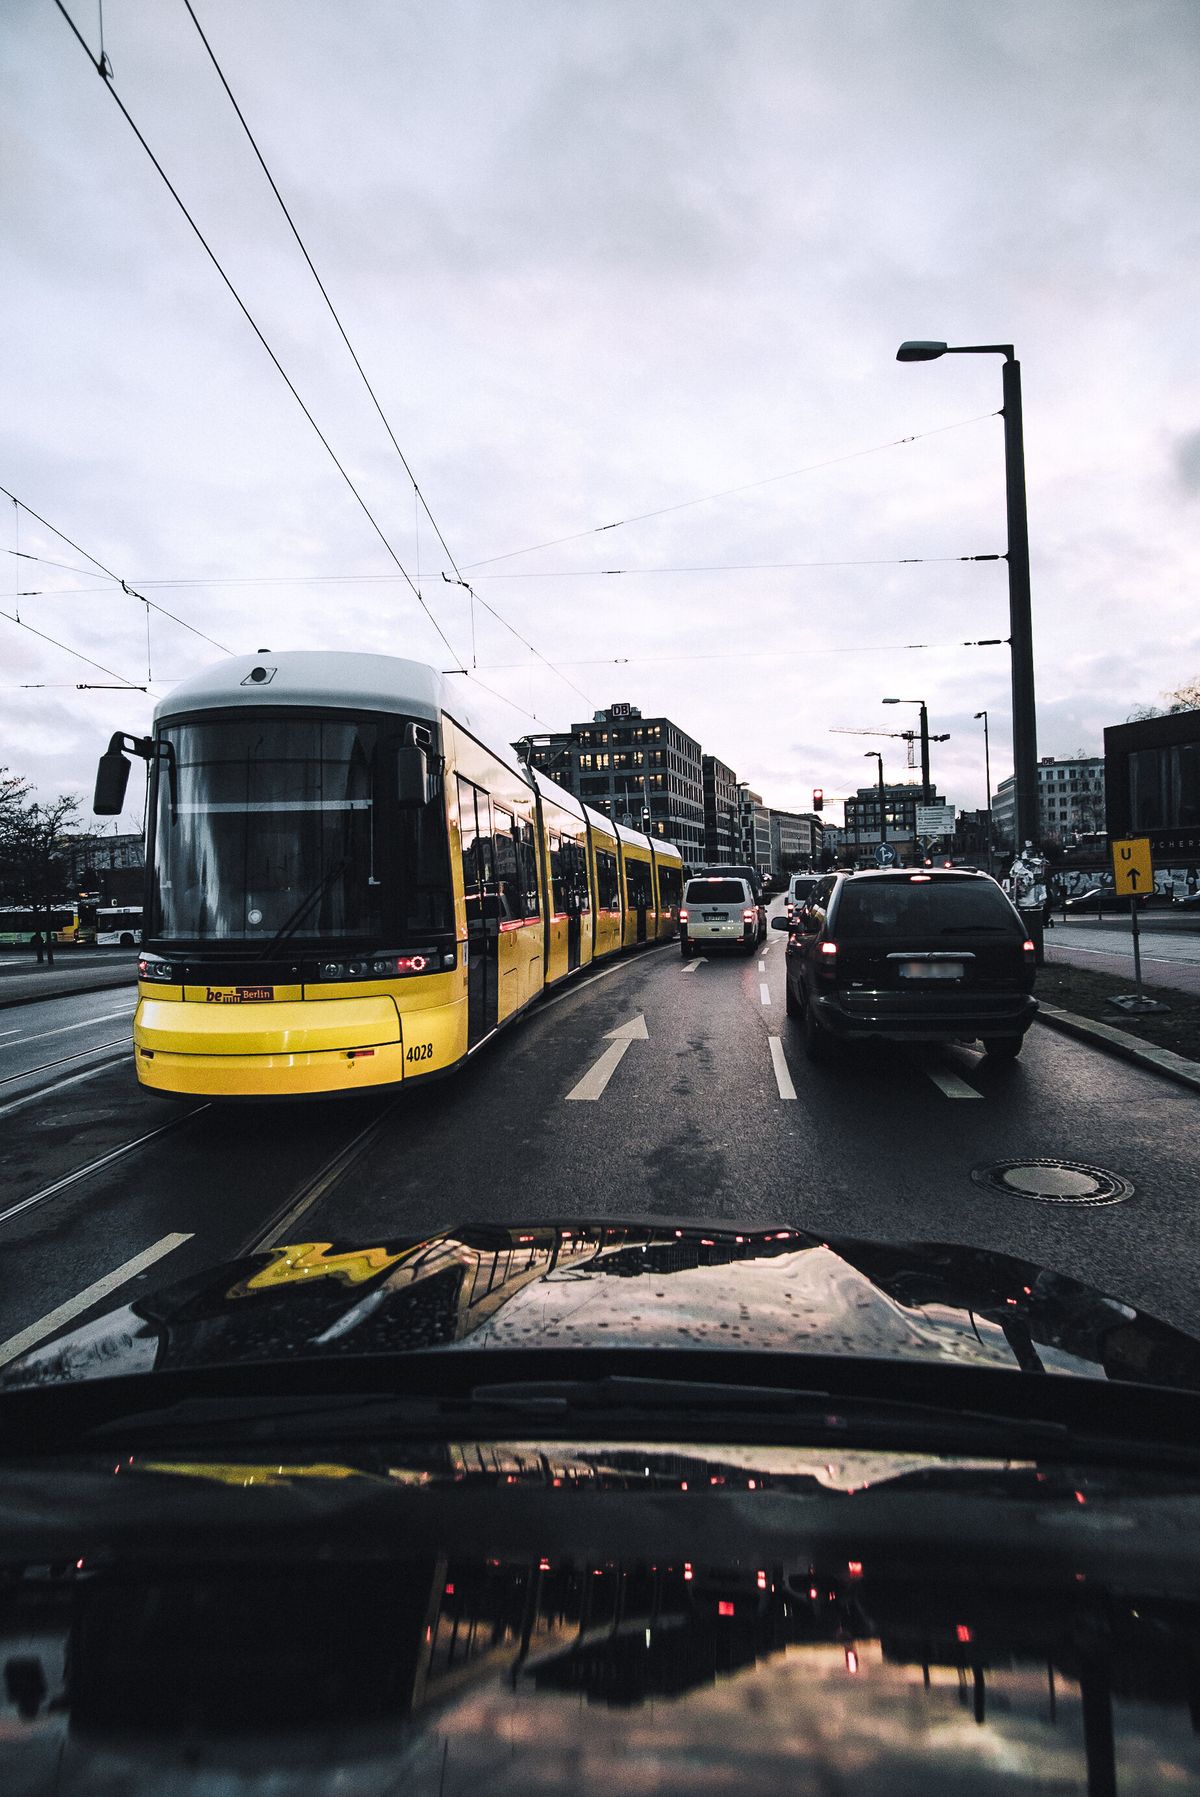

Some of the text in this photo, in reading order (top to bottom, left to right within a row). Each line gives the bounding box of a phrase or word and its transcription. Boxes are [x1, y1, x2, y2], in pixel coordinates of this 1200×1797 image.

[613, 704, 629, 716] DB
[1121, 848, 1131, 860] U
[206, 987, 270, 1002] be Berlin
[406, 1042, 433, 1063] 4028
